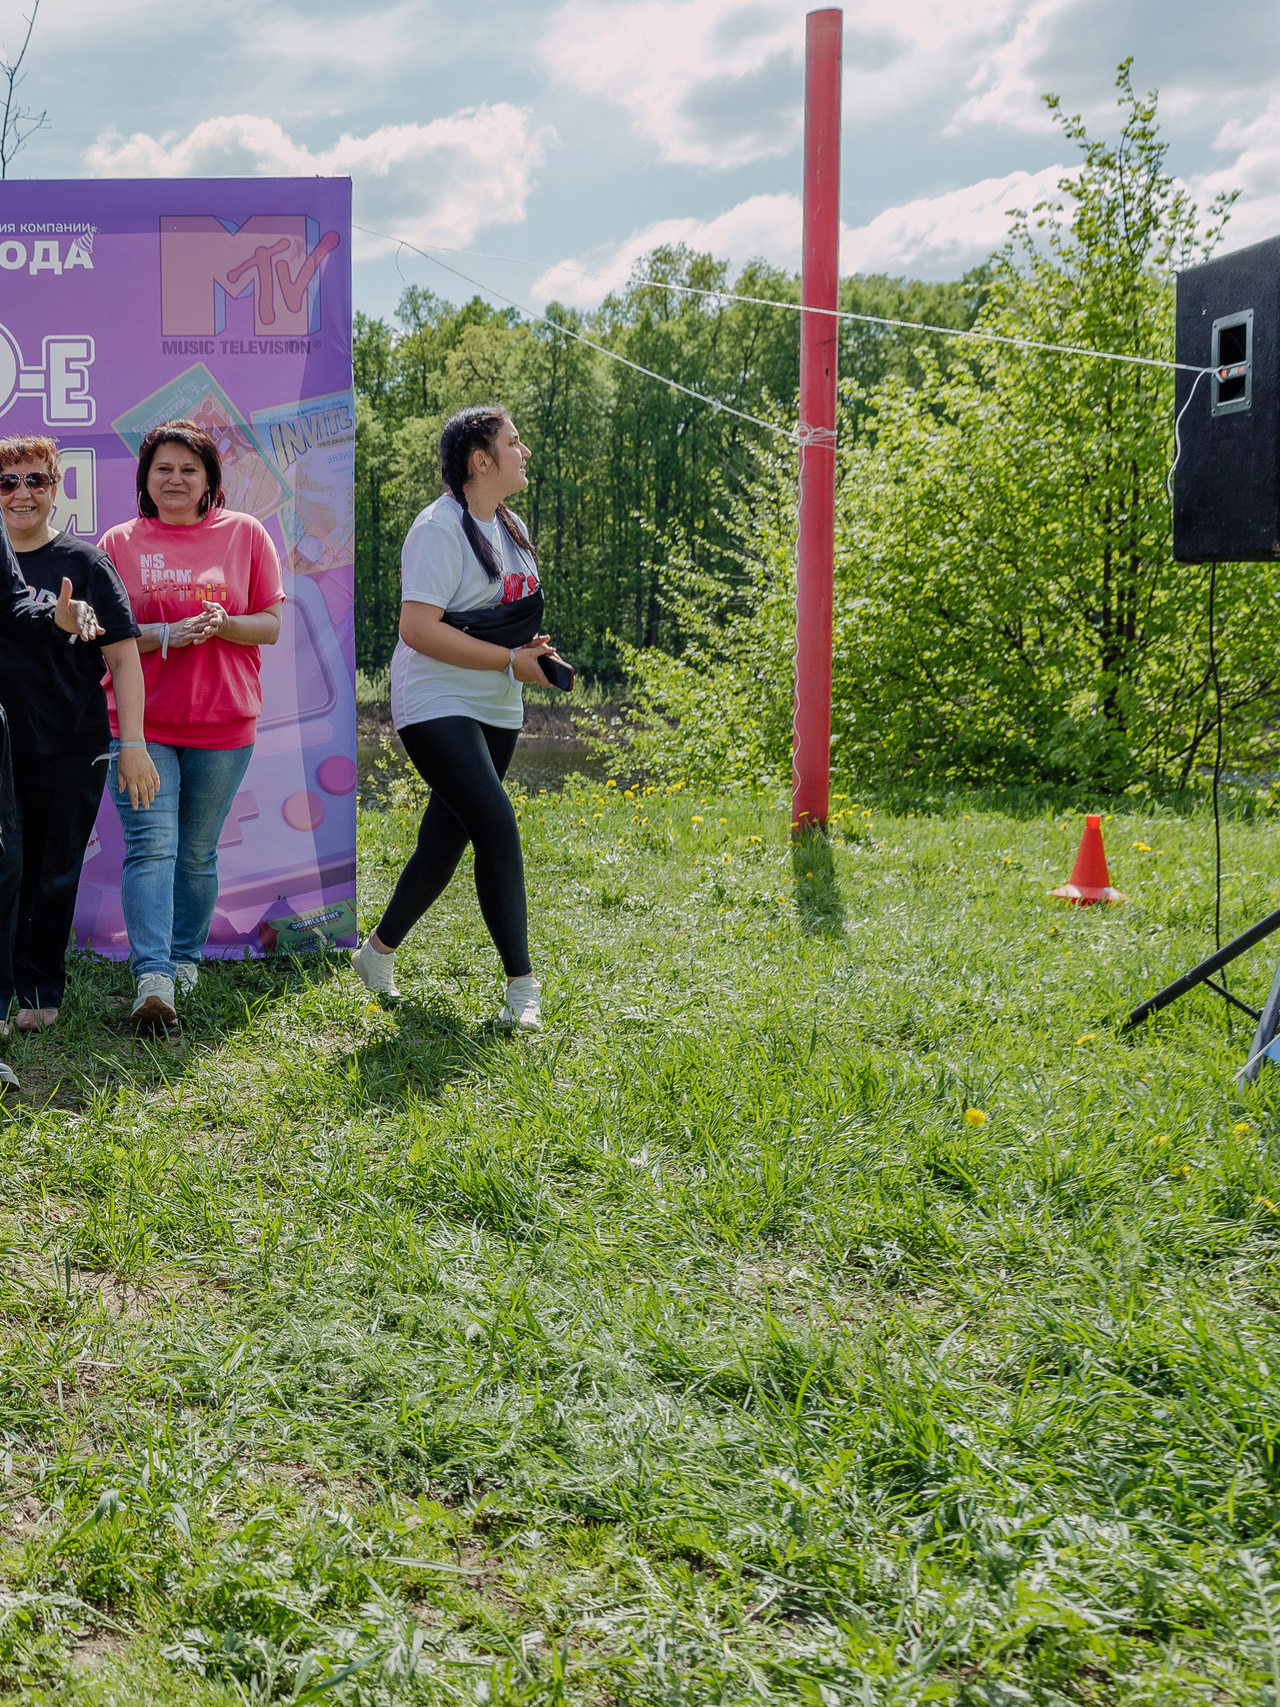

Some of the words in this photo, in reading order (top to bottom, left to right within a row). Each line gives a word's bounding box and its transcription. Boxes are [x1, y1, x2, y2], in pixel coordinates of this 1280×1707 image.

[20, 222, 90, 233] компании
[162, 340, 215, 355] MUSIC
[270, 406, 353, 474] INVITE
[141, 568, 192, 585] FROM
[291, 911, 339, 930] DOUBLEMINT
